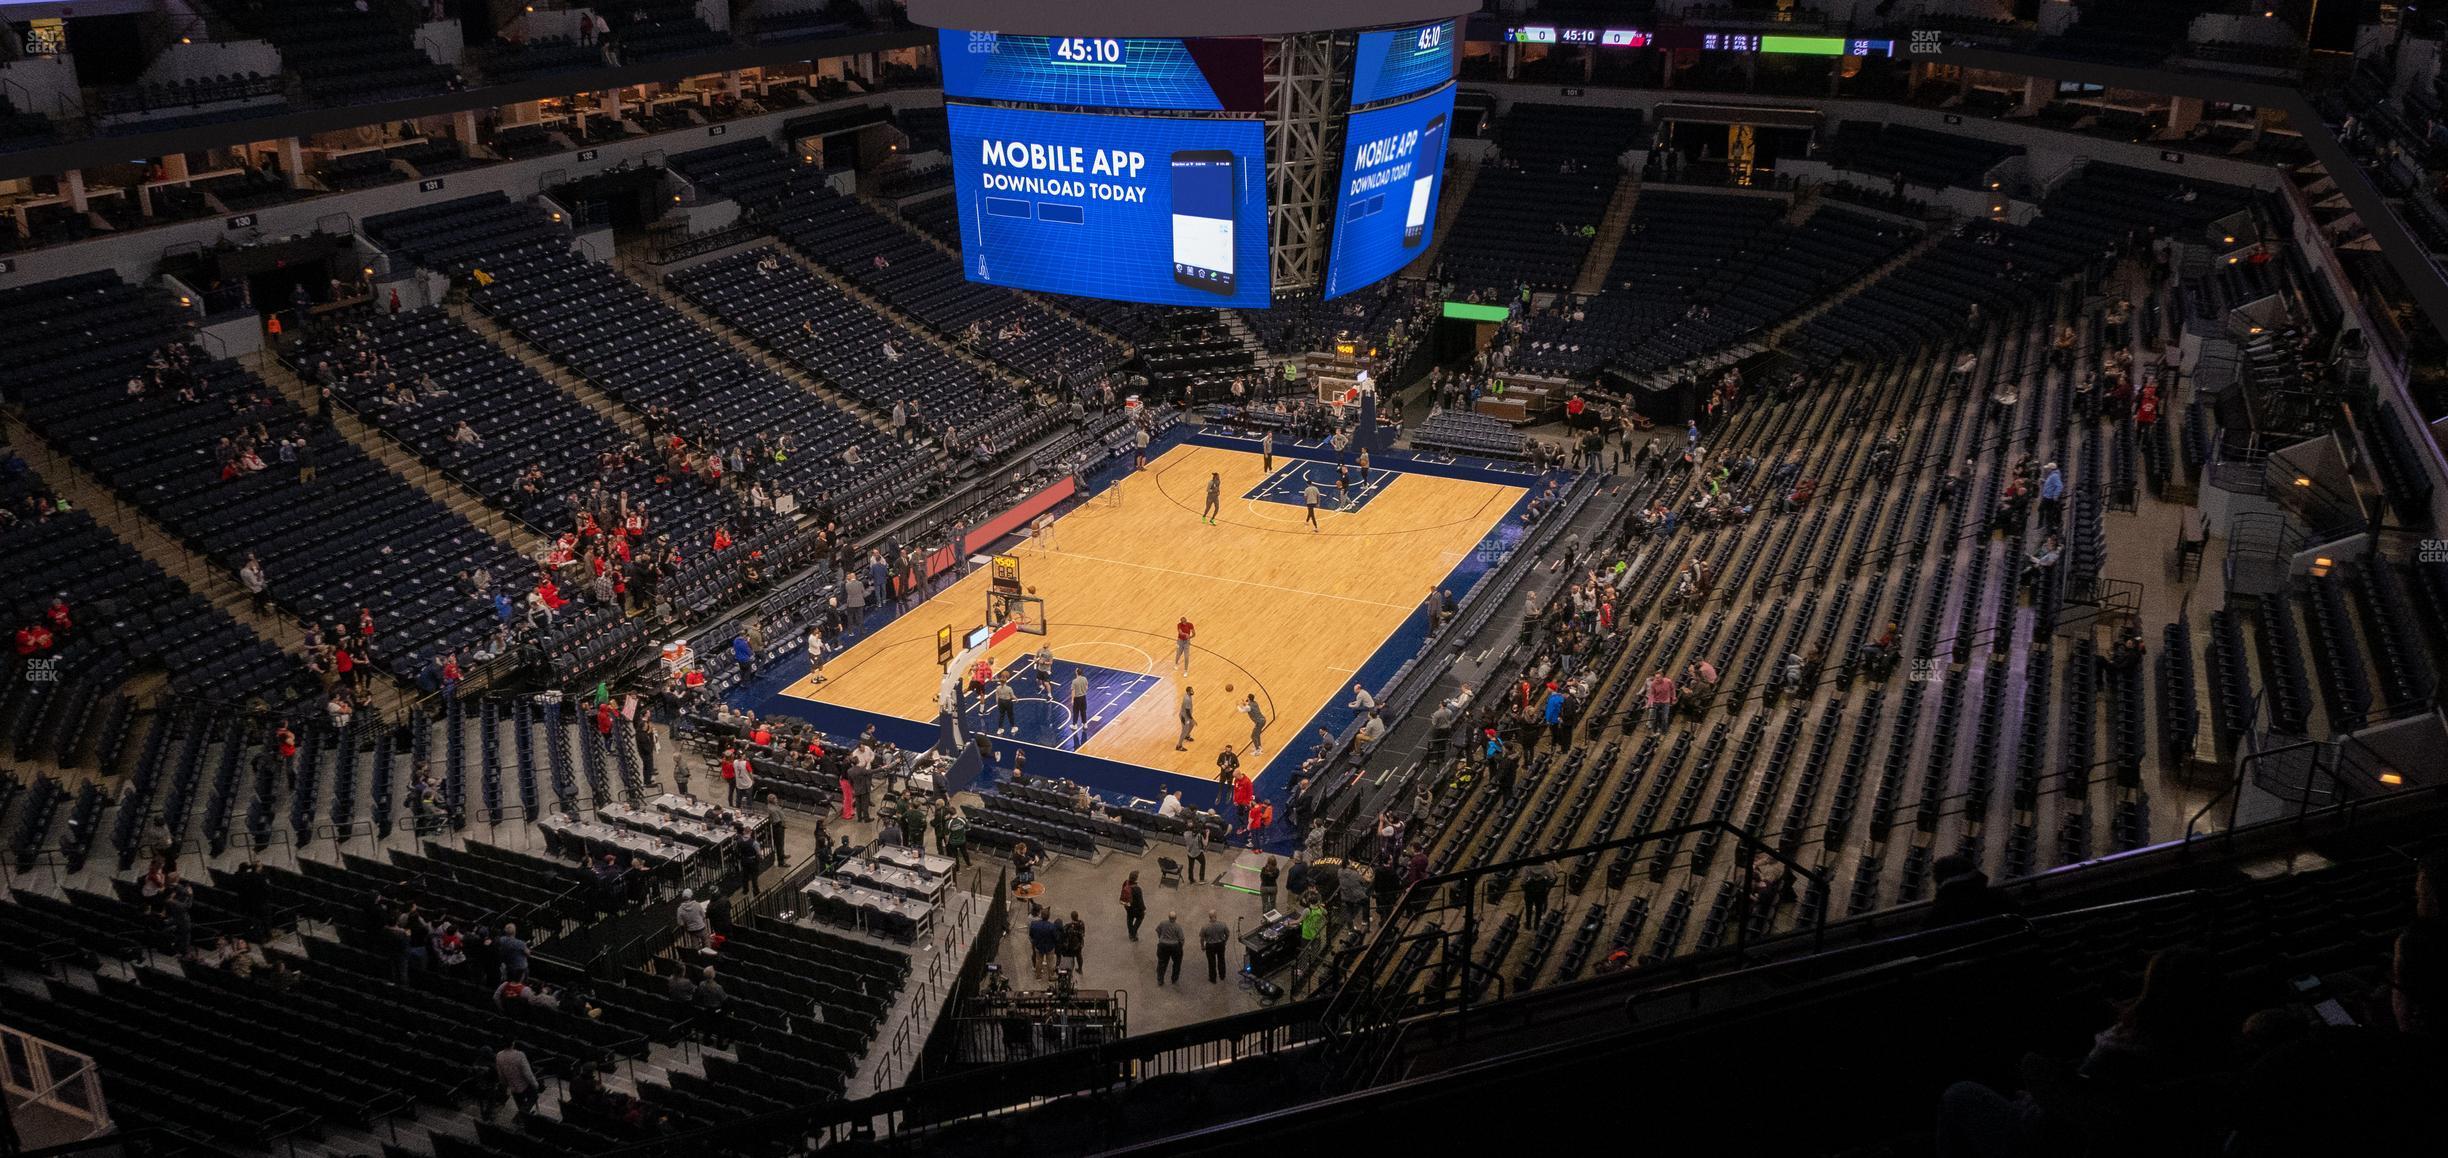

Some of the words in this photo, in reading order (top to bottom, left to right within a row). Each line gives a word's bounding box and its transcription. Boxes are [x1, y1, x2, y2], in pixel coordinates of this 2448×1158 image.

[1418, 25, 1441, 50] 45:10
[1539, 31, 1545, 40] 0
[1563, 30, 1594, 41] 45:10
[1614, 34, 1620, 43] 0
[1854, 40, 1869, 48] CLE
[1057, 38, 1119, 62] 45:10
[982, 139, 1084, 174] MOBILE
[1091, 148, 1145, 178] APP
[1354, 135, 1399, 172] MOBILE
[1395, 129, 1418, 159] APP
[425, 180, 438, 190] 131
[982, 172, 1085, 197] DOWNLOAD
[1089, 182, 1146, 203] TODAY
[1350, 168, 1391, 197] DOWNLOAD
[1390, 161, 1413, 183] TODAY
[235, 216, 251, 227] 130
